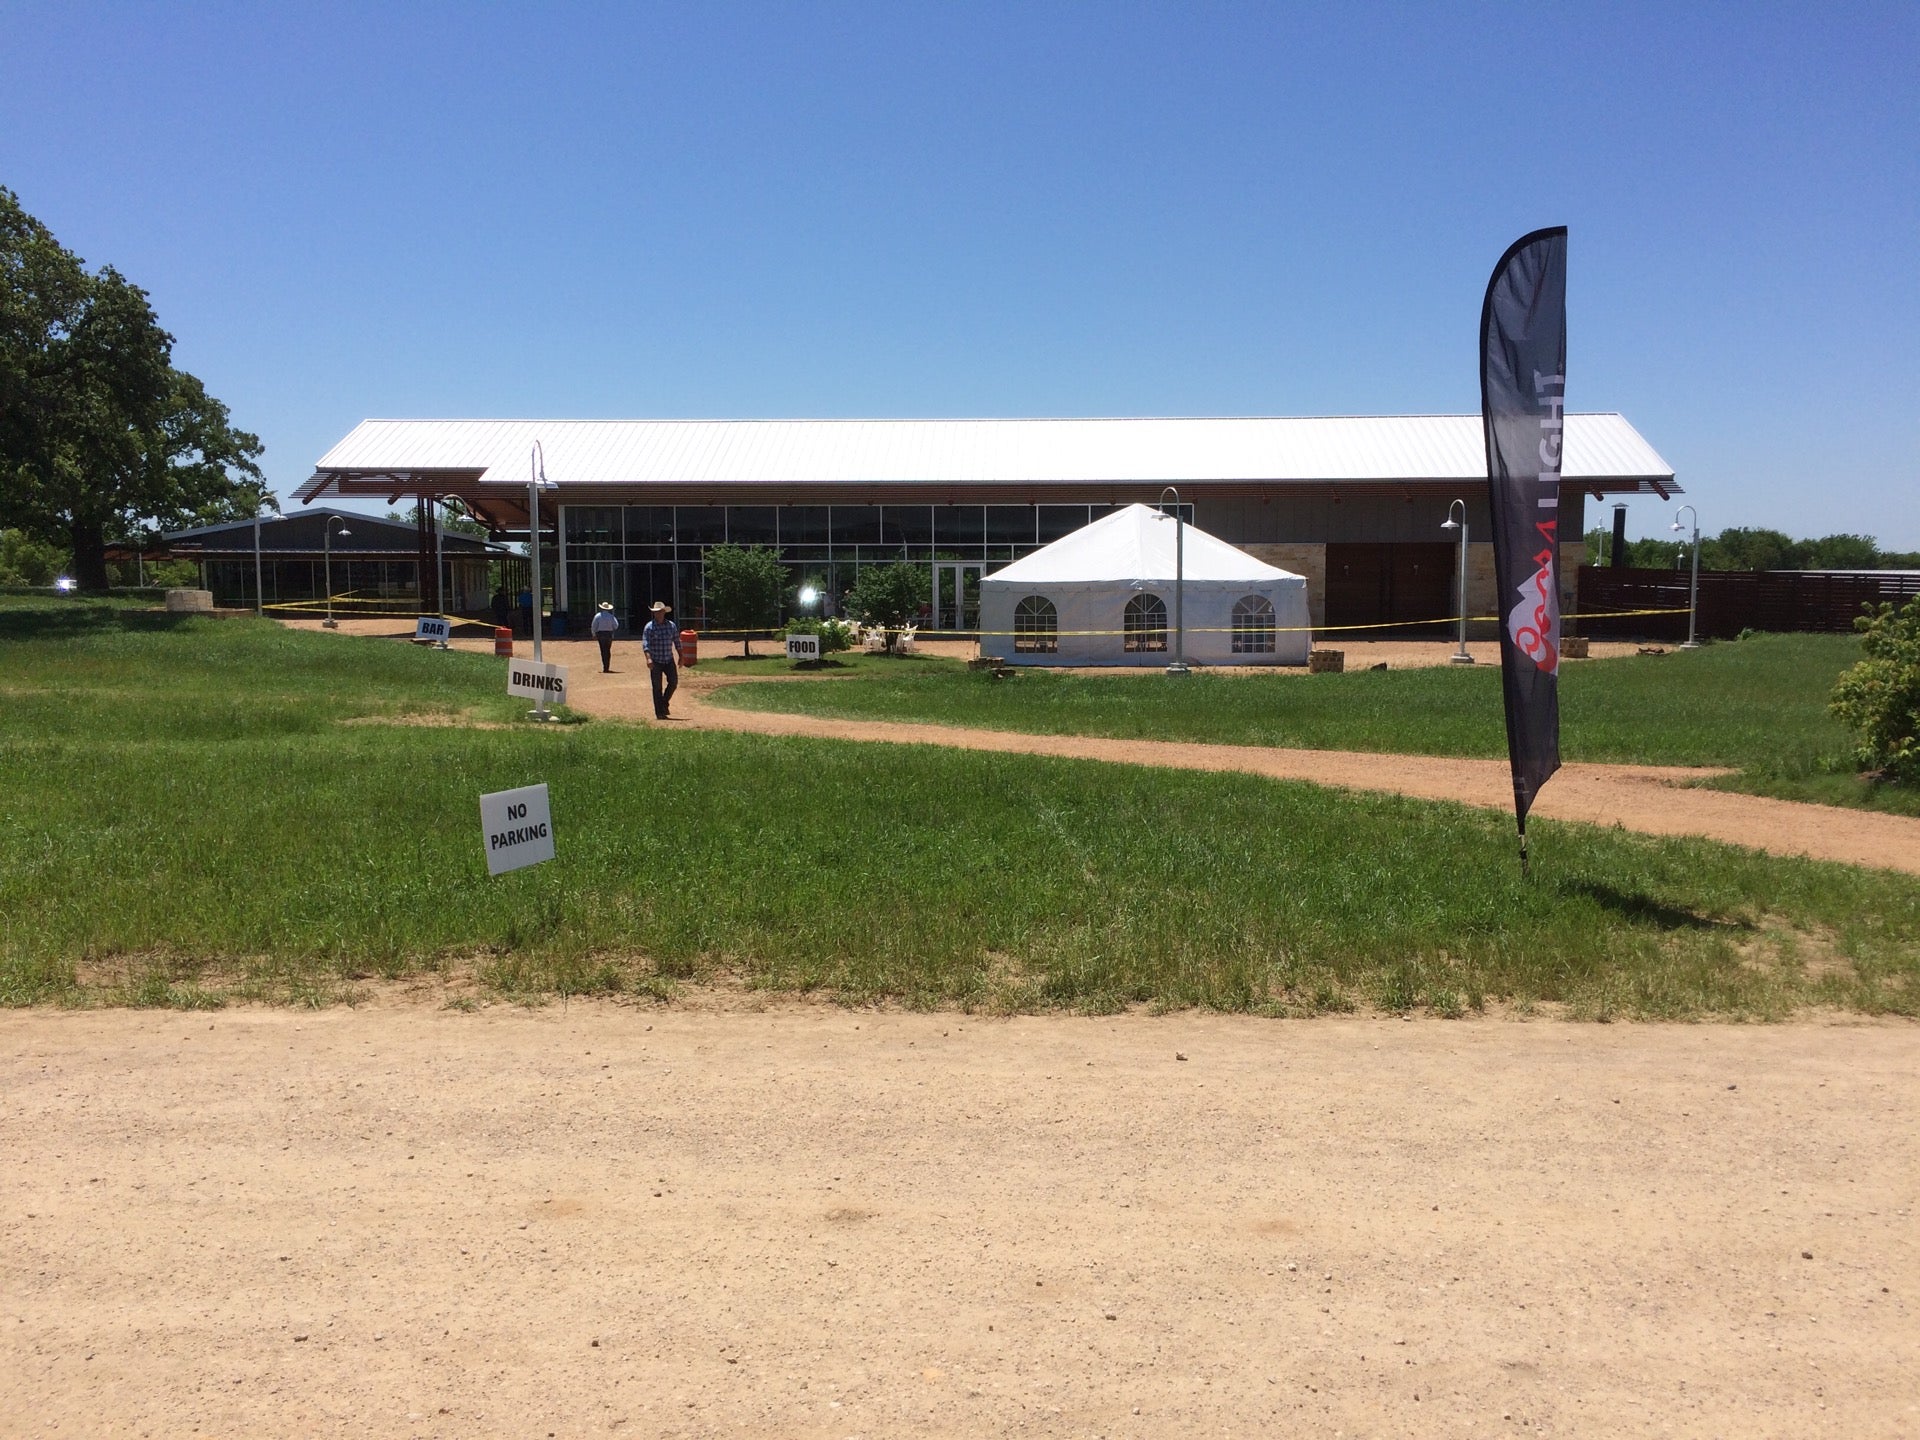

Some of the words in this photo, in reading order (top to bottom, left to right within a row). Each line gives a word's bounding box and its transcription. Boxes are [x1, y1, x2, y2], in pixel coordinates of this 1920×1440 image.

[1533, 369, 1565, 508] LIGHT
[421, 622, 445, 636] BAR
[789, 640, 816, 653] FOOD
[512, 671, 563, 693] DRINKS
[507, 803, 527, 821] NO
[490, 823, 547, 850] PARKING
